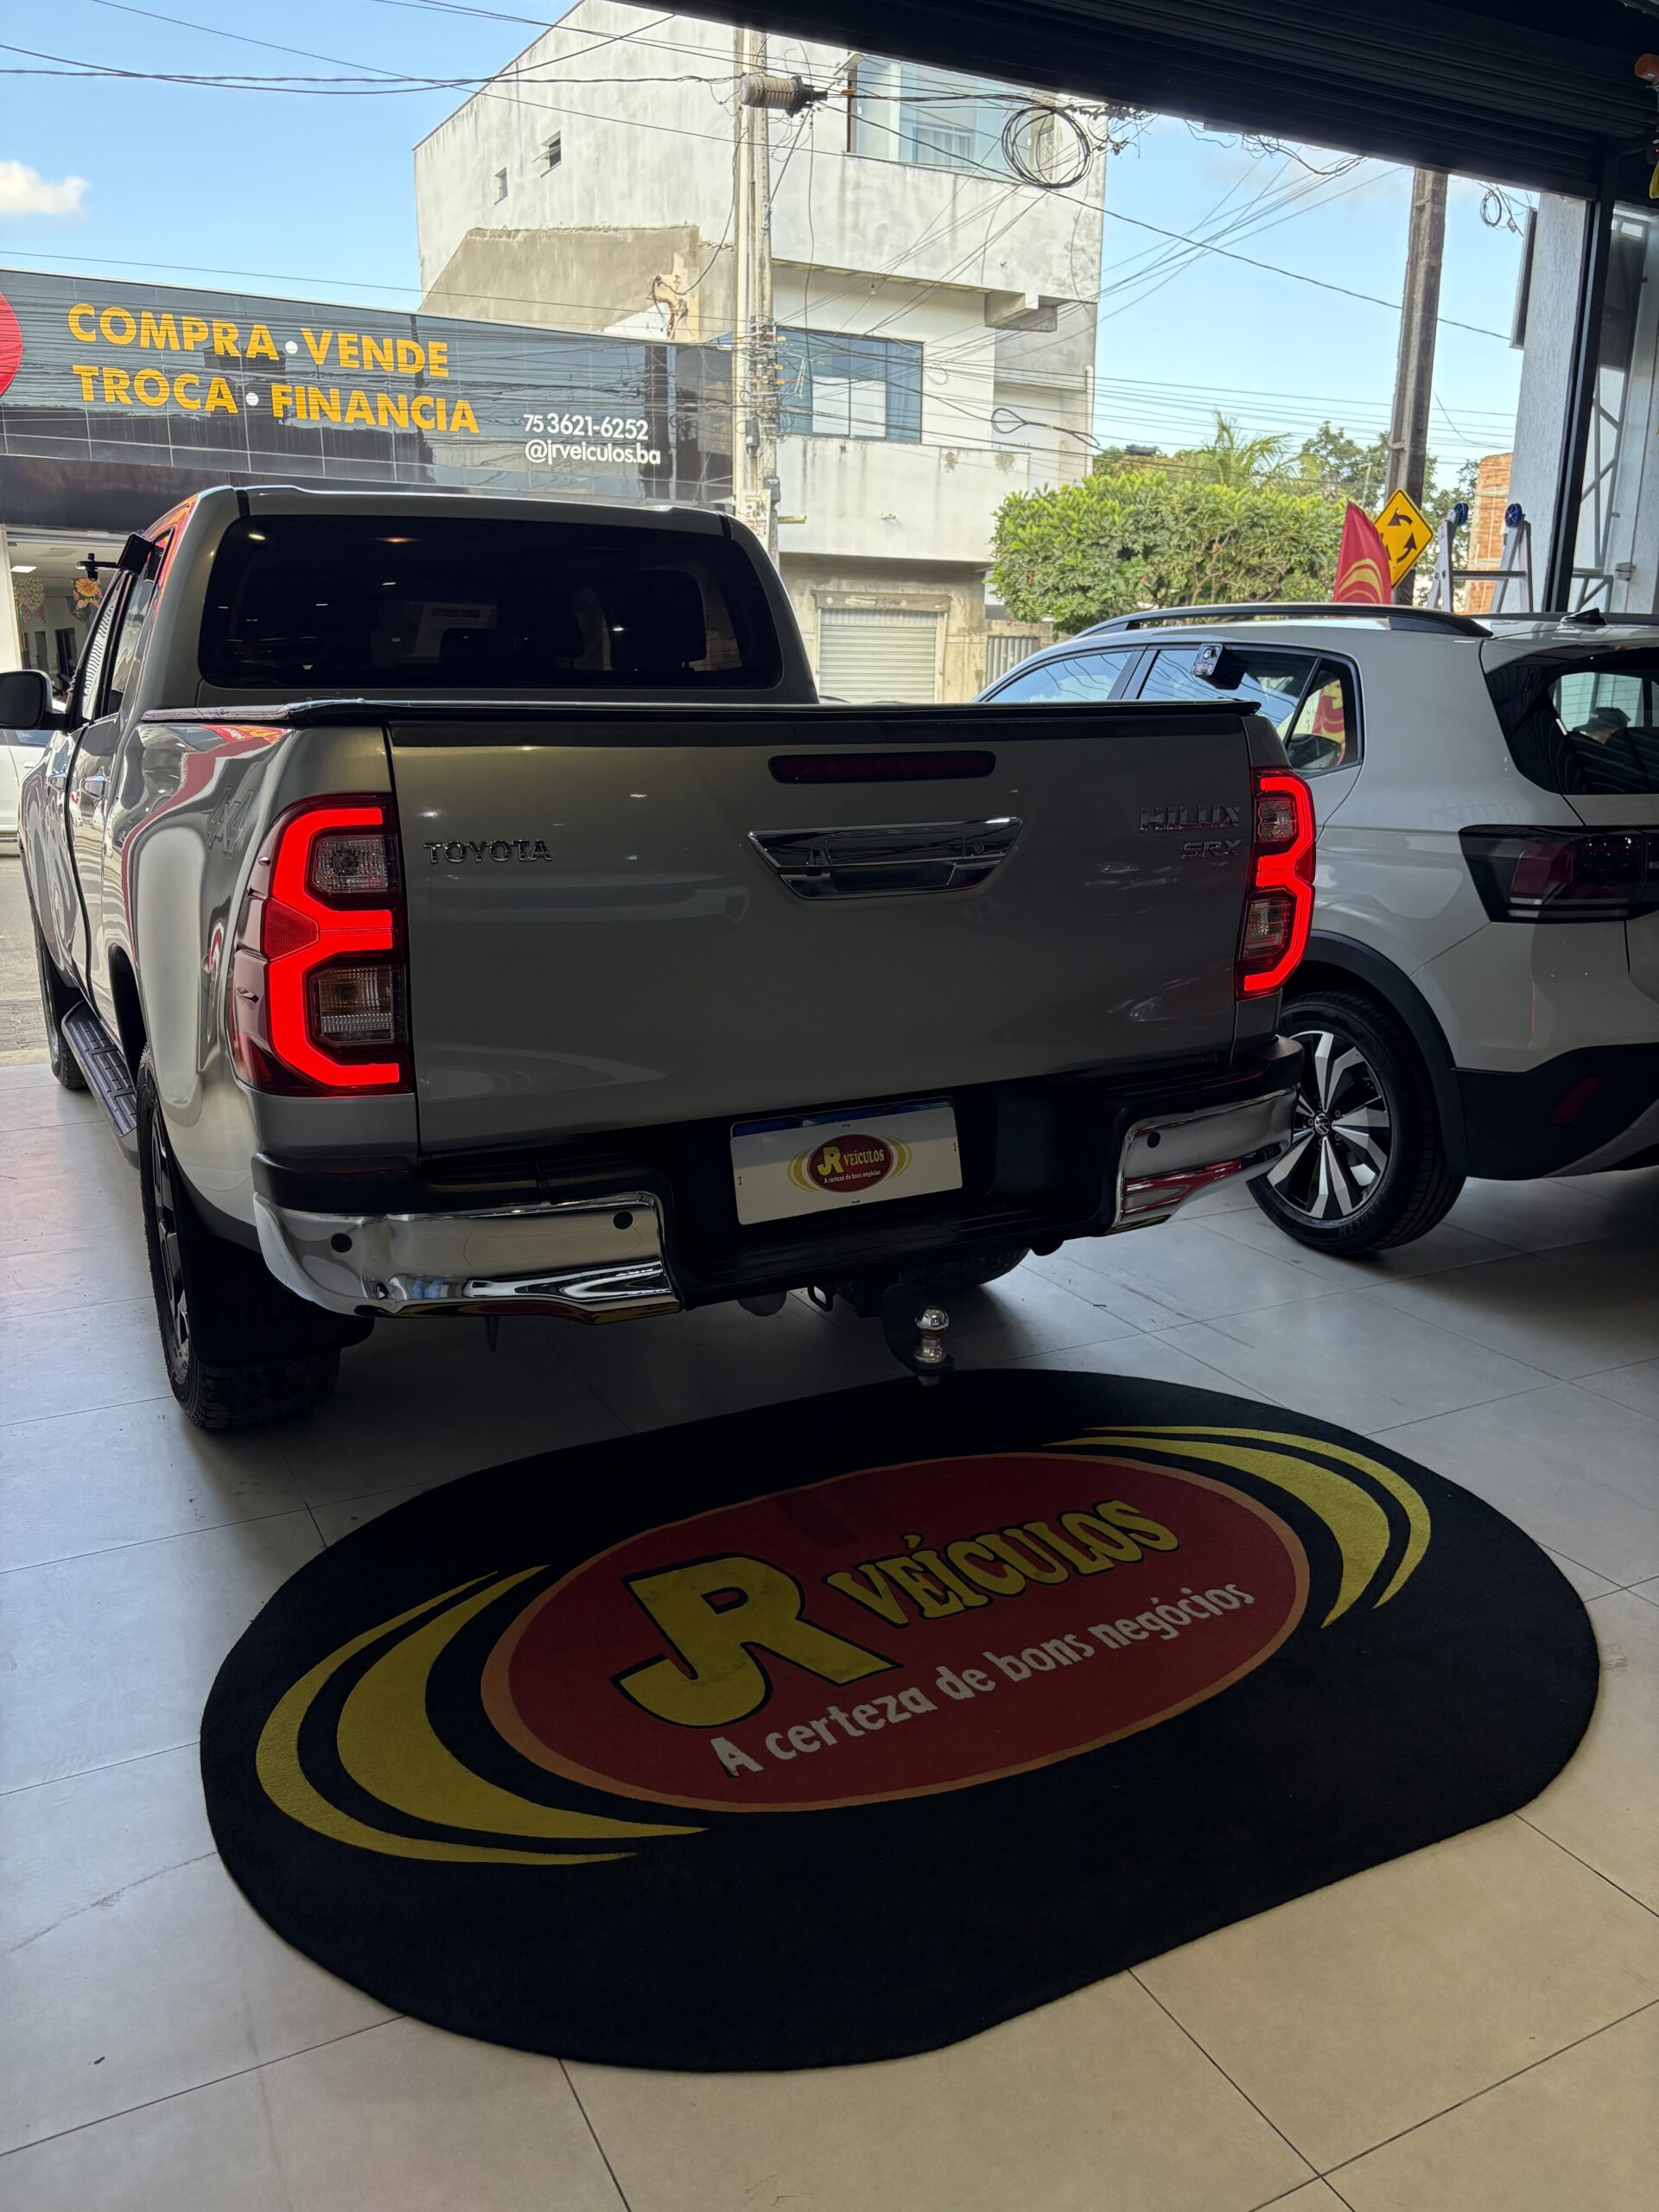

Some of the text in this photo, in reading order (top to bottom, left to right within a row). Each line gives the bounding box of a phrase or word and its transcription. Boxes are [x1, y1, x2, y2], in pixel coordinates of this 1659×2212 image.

[68, 303, 449, 378] COMPRA VENDE
[72, 365, 480, 434] TROCA FINANCIA
[523, 413, 649, 440] 75 3621-6252
[524, 439, 661, 465] @jrveiculos.ba
[1140, 804, 1241, 831] HILUX
[423, 839, 552, 863] TOYOTA
[1182, 839, 1242, 859] SRX
[817, 1147, 885, 1175] JR VEÍCULOS
[610, 1499, 1181, 1729] JR VEÍCULOS
[710, 1583, 1255, 1777] A certeza de bons negócios
